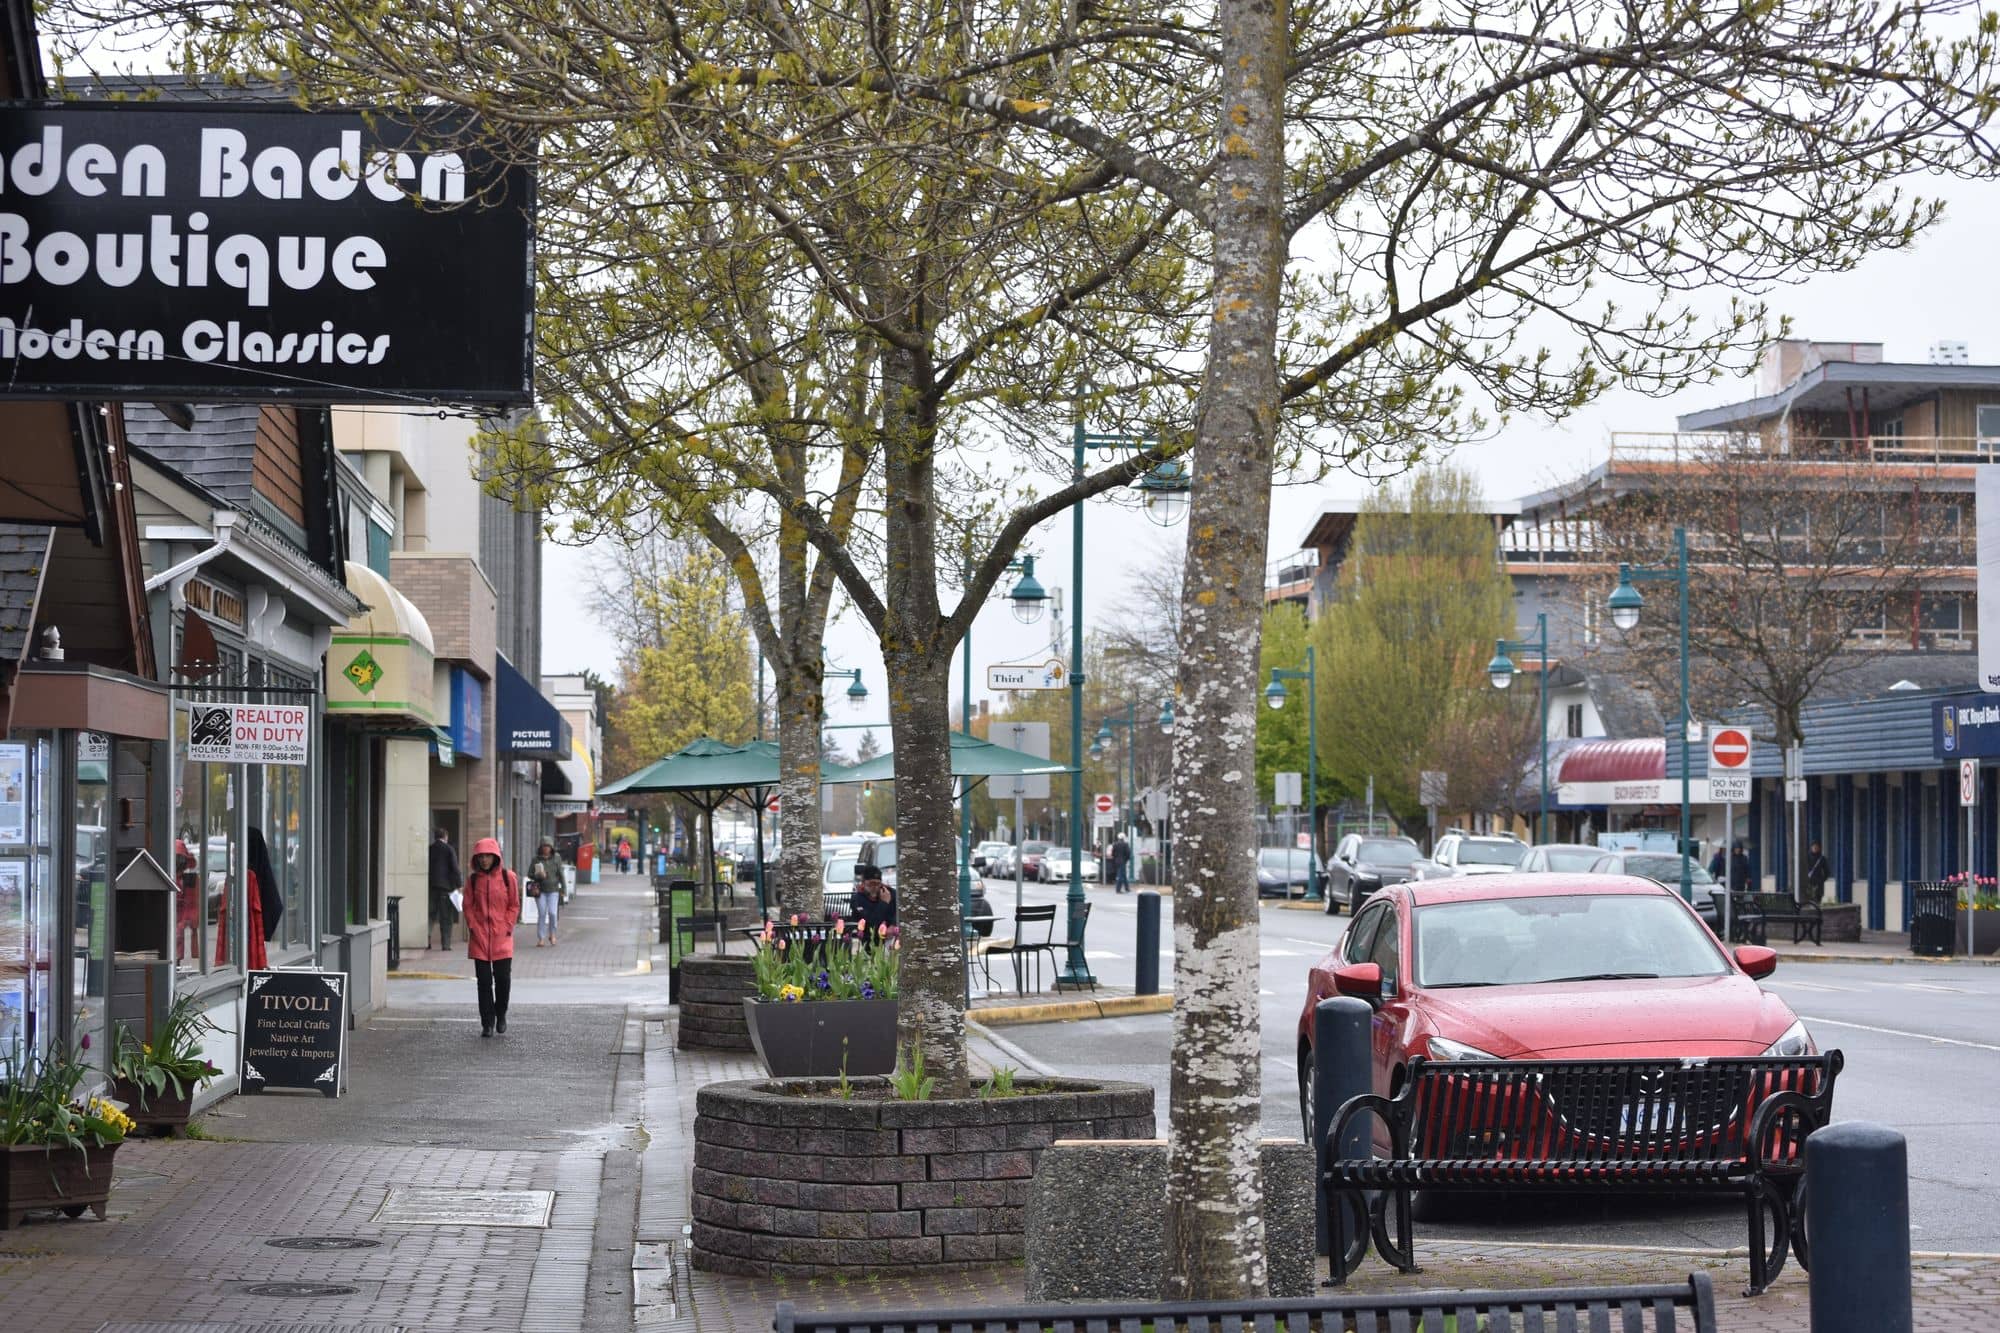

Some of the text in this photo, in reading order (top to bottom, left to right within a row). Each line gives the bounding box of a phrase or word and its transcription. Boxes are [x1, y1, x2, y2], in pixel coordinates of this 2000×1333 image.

[0, 125, 465, 202] den Baden
[0, 211, 387, 306] Boutique
[182, 318, 390, 365] Classics
[993, 674, 1024, 683] Third
[236, 709, 304, 725] REALTOR
[1970, 706, 1985, 728] Royal
[235, 727, 304, 742] ON DUTY
[512, 730, 551, 738] PICTURE
[511, 740, 552, 748] FRAMING
[191, 746, 231, 754] HOLMES
[234, 752, 244, 760] OR
[1712, 779, 1747, 788] DO NOT
[1715, 789, 1745, 798] ENTER
[260, 995, 329, 1011] TIVOLI
[257, 1019, 330, 1030] Fine Local Crafts
[270, 1034, 315, 1043] Native Art
[249, 1047, 335, 1060] Jewellery & Imports
